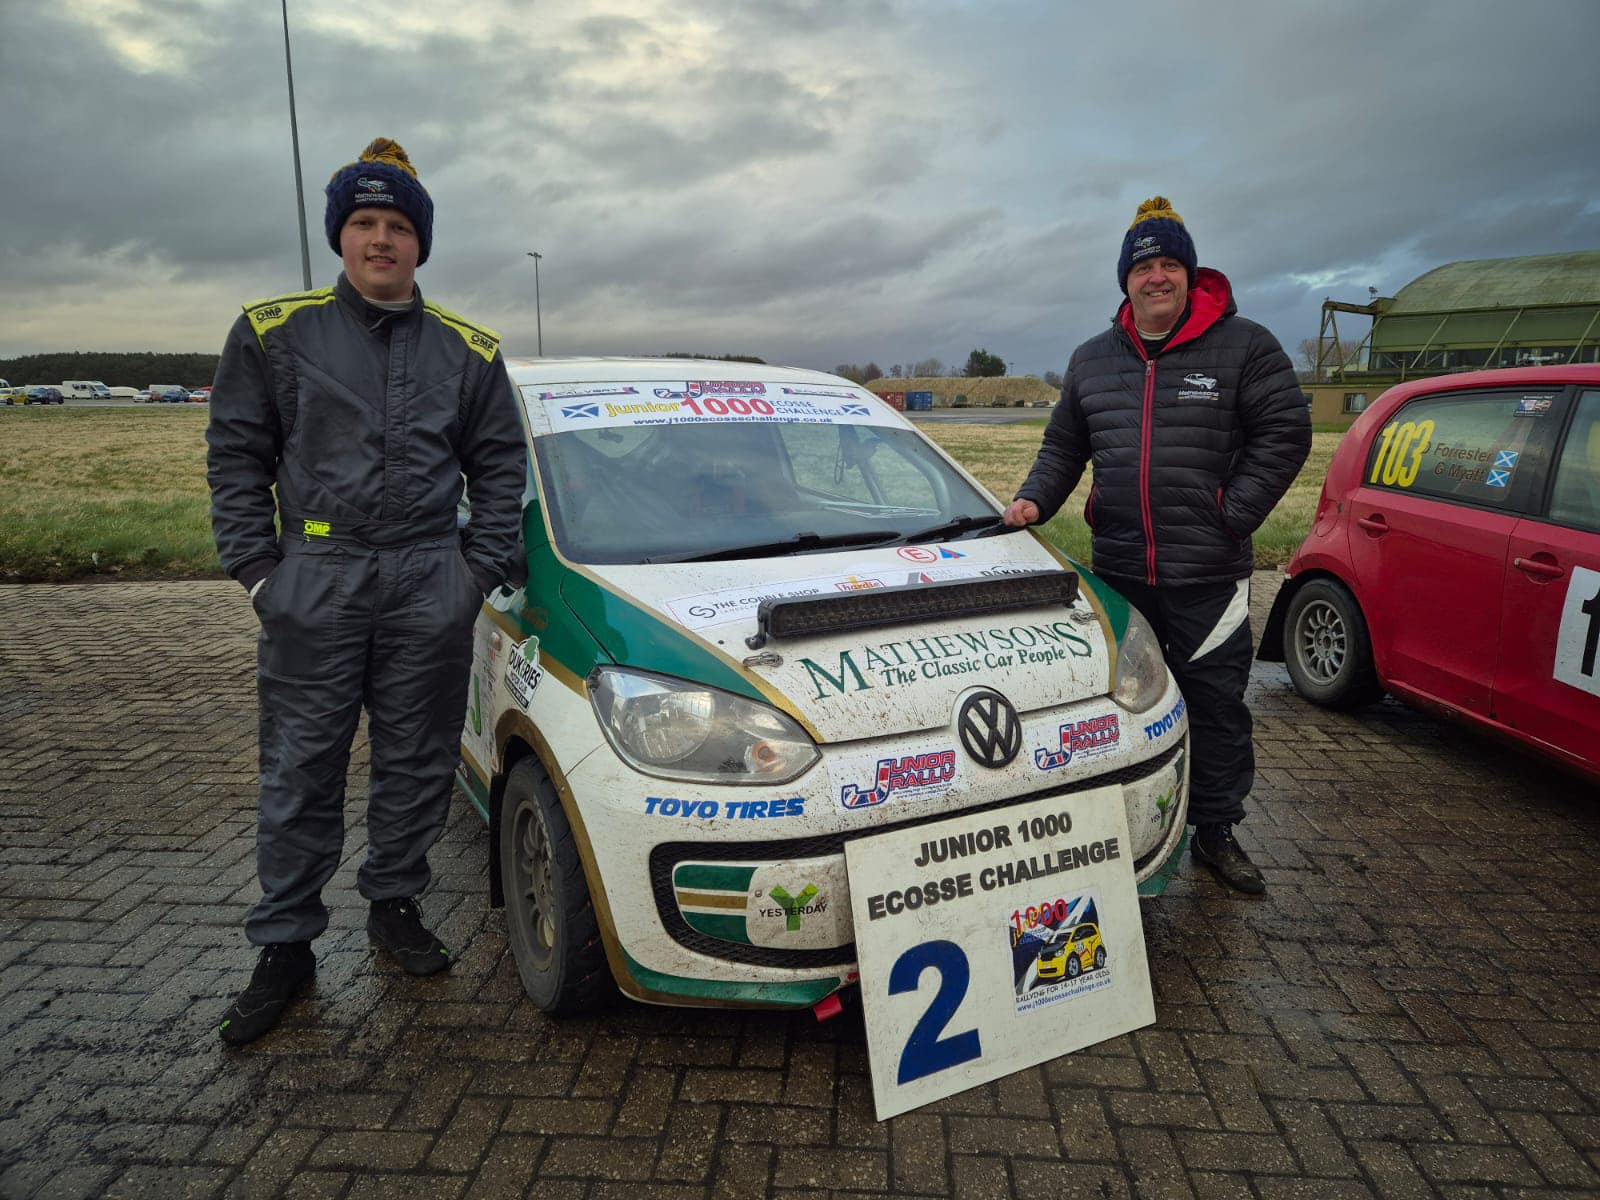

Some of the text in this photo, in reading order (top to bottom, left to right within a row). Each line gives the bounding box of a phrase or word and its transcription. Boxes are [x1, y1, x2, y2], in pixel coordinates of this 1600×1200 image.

[256, 307, 282, 321] OMP
[471, 334, 494, 350] OMP
[605, 398, 775, 417] junior 1000
[770, 400, 816, 408] ECOSSE
[776, 407, 844, 416] CHALLENGE
[1370, 419, 1435, 487] 103
[1434, 443, 1493, 462] Forrester
[1449, 464, 1485, 481] Myatt
[304, 522, 331, 535] OMP
[713, 599, 743, 610] THE
[881, 647, 1067, 687] The Classic Car People
[1144, 713, 1173, 740] TOYO
[1071, 728, 1120, 752] RALLY
[890, 767, 956, 791] RALLY
[645, 797, 805, 819] TOYO TIRES
[914, 812, 1073, 867] JUNIOR 1000
[867, 838, 1120, 921] ECOSSE CHALLENGE
[759, 903, 828, 918] YESTERDAY
[1010, 898, 1067, 936] 1000
[1046, 985, 1059, 995] FOR
[888, 940, 982, 1086] 2
